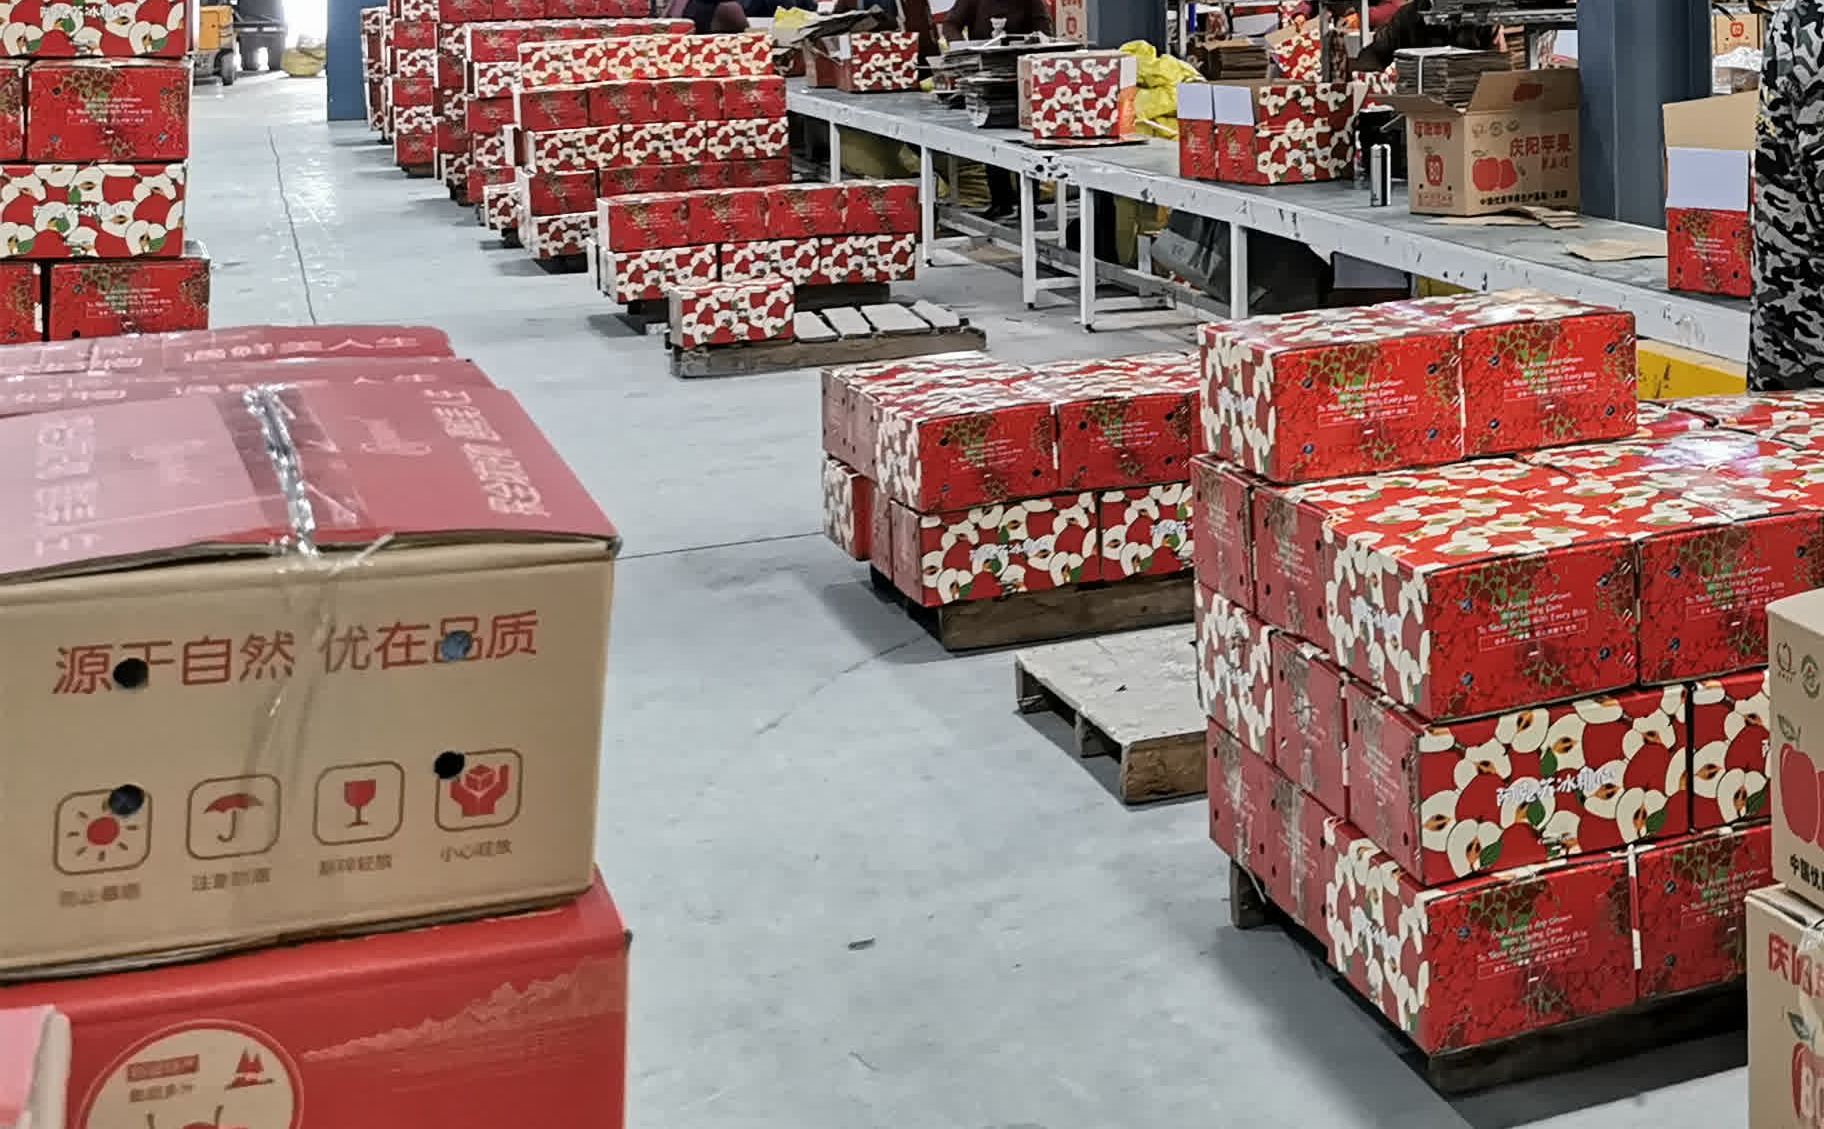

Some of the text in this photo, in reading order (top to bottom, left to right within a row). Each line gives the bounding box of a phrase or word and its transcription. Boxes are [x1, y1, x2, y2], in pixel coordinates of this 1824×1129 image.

[52, 608, 540, 696] 源于自然 优在品质
